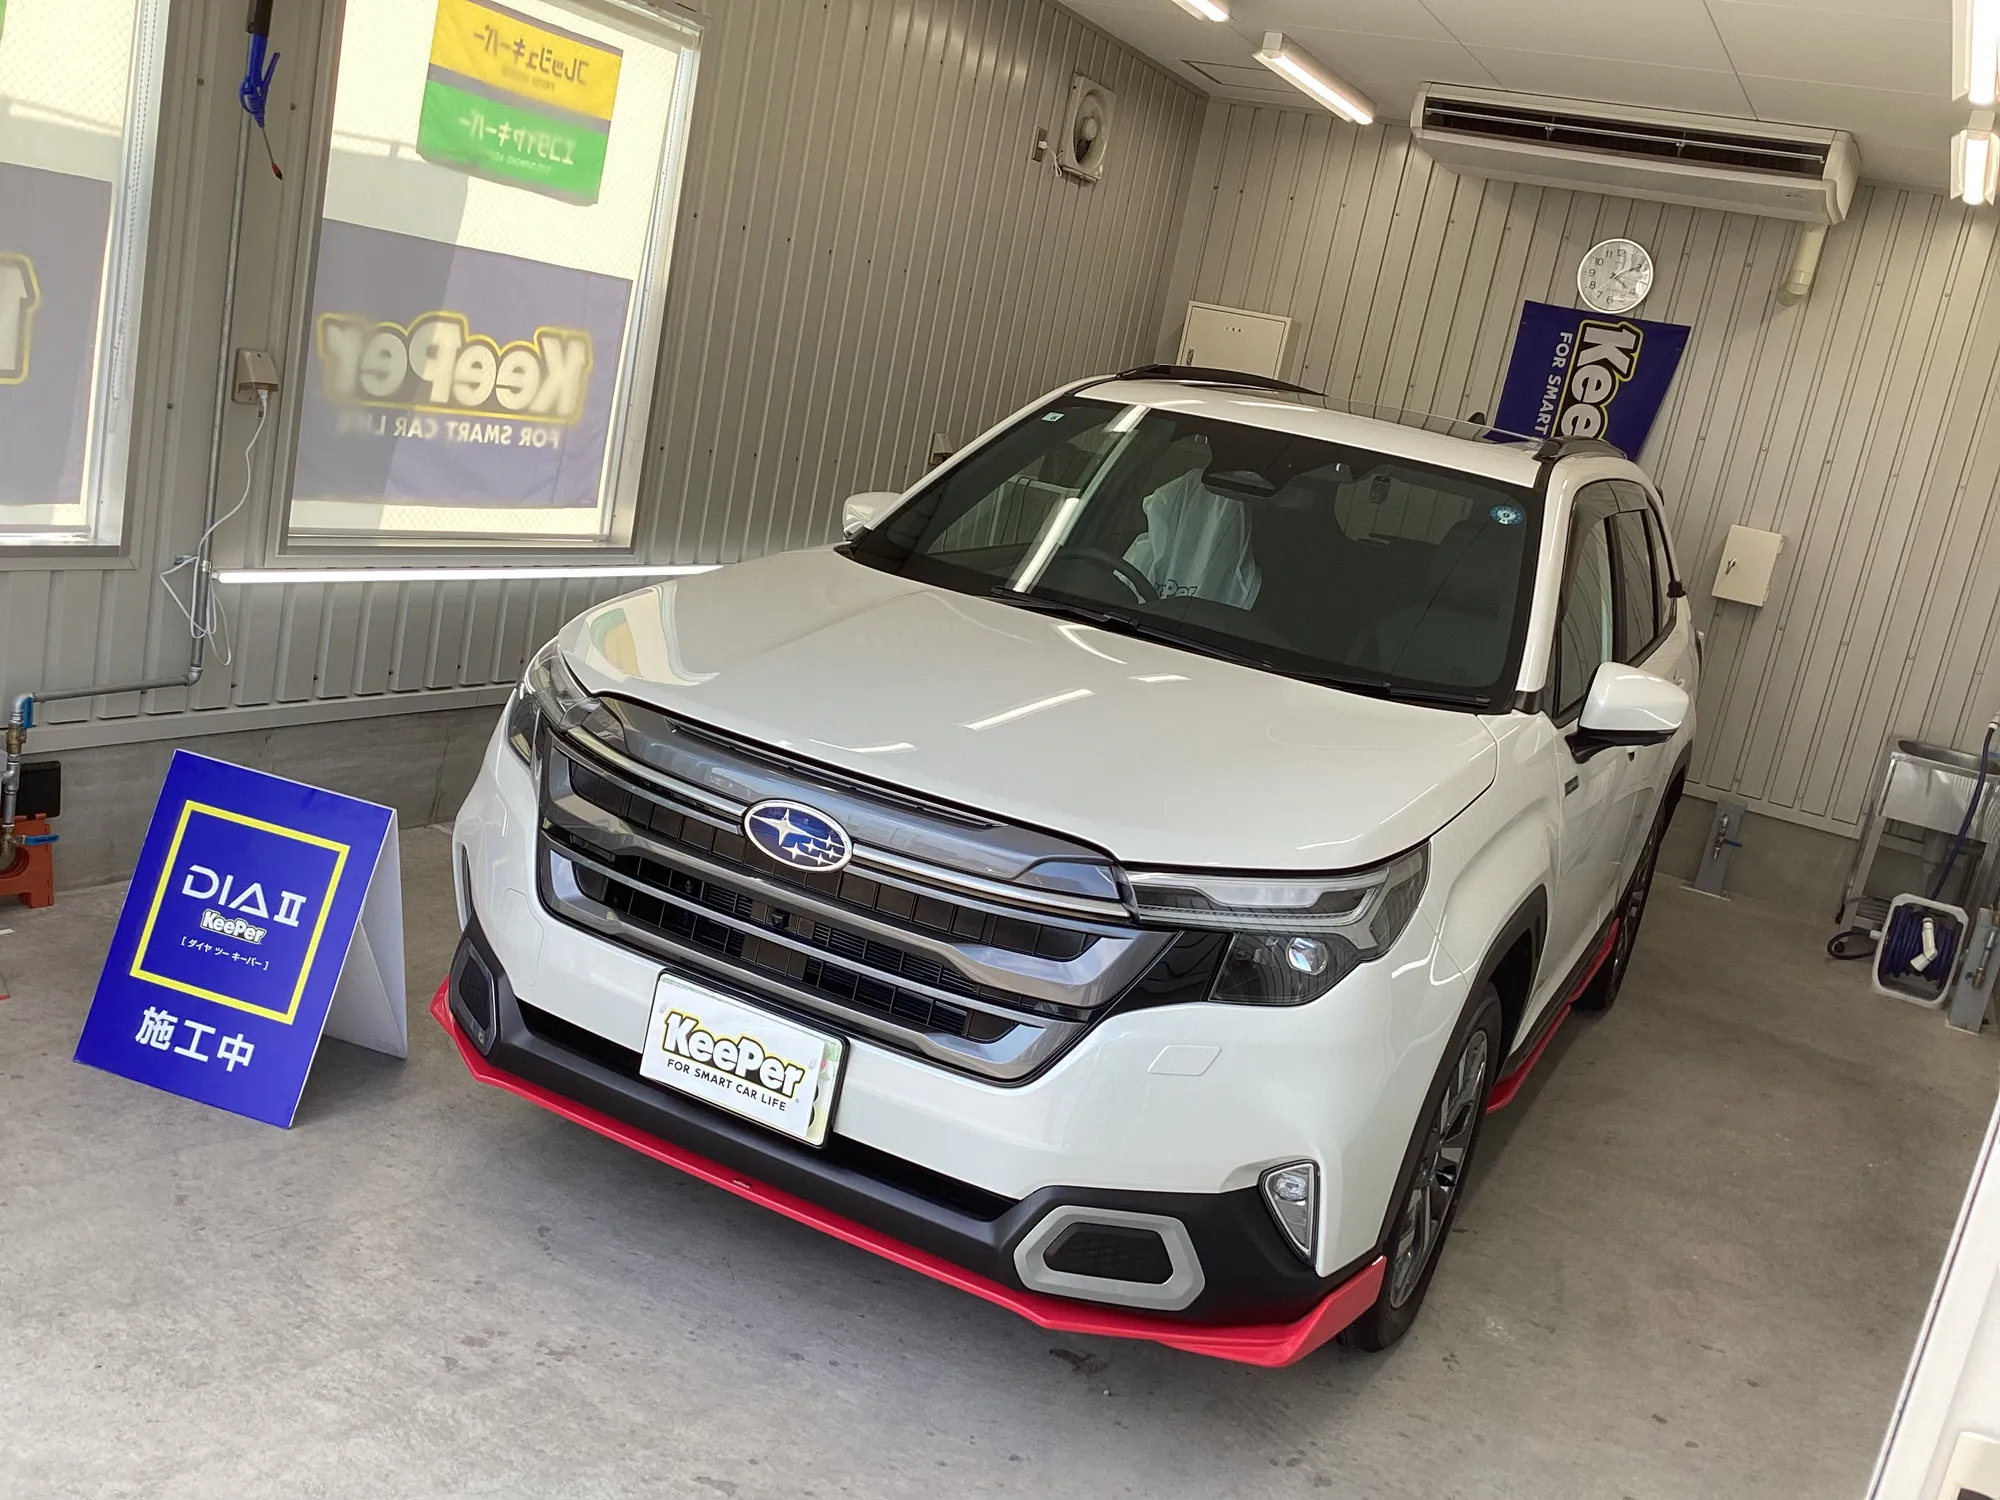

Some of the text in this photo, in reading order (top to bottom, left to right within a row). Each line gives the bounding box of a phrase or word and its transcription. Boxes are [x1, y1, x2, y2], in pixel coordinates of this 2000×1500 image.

[1588, 268, 1596, 277] 9
[1594, 257, 1604, 266] 10
[1605, 250, 1613, 259] 11
[1588, 280, 1597, 290] 8
[1606, 295, 1613, 304] 6
[1534, 331, 1574, 436] FOR SMART
[1558, 324, 1639, 437] Kee
[182, 864, 269, 919] DIA
[200, 908, 267, 945] KeePer
[187, 938, 212, 953] ダイヤ
[135, 1005, 255, 1073] 施工中
[661, 1009, 806, 1100] KeePer
[667, 1058, 690, 1075] FOR
[693, 1067, 733, 1090] SMART
[735, 1083, 758, 1101] CAR
[761, 1094, 787, 1112] LIFE
